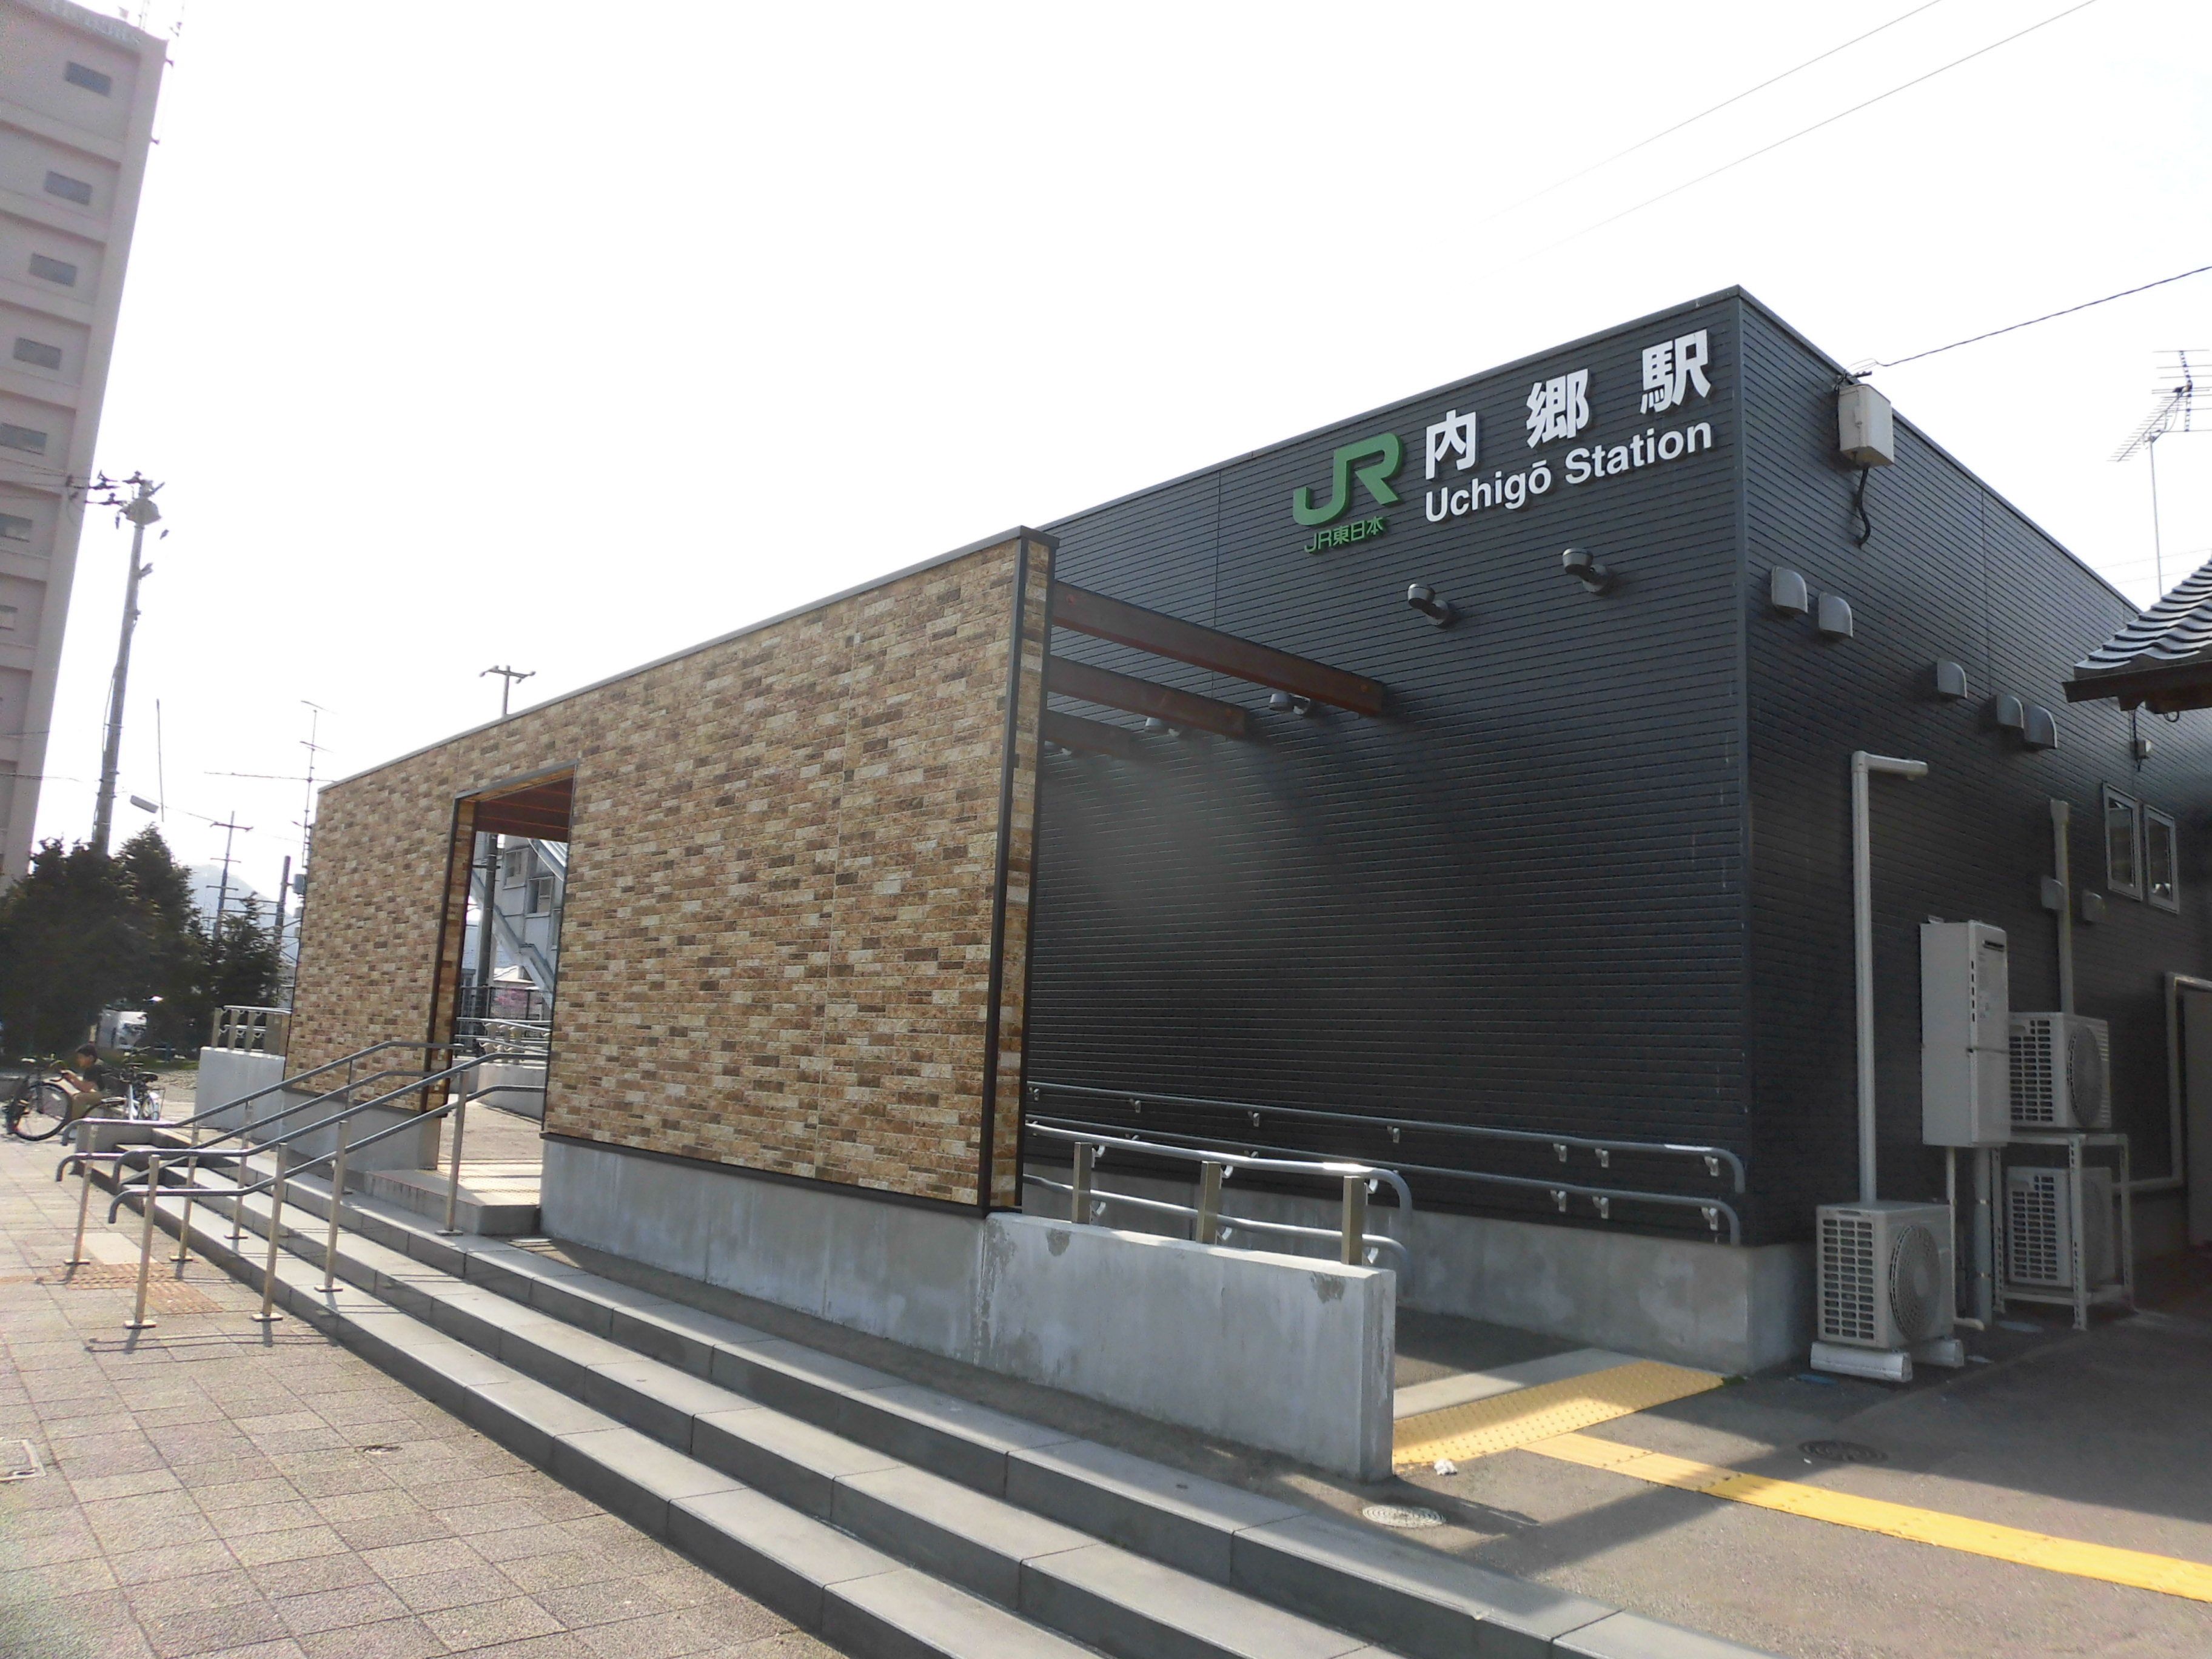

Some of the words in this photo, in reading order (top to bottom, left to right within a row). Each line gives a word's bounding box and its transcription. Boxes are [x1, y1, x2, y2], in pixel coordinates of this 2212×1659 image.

[1293, 433, 1401, 525] JR
[1426, 461, 1550, 522] Uchigō
[1565, 422, 1711, 484] Station
[1304, 516, 1385, 552] JR東日本
